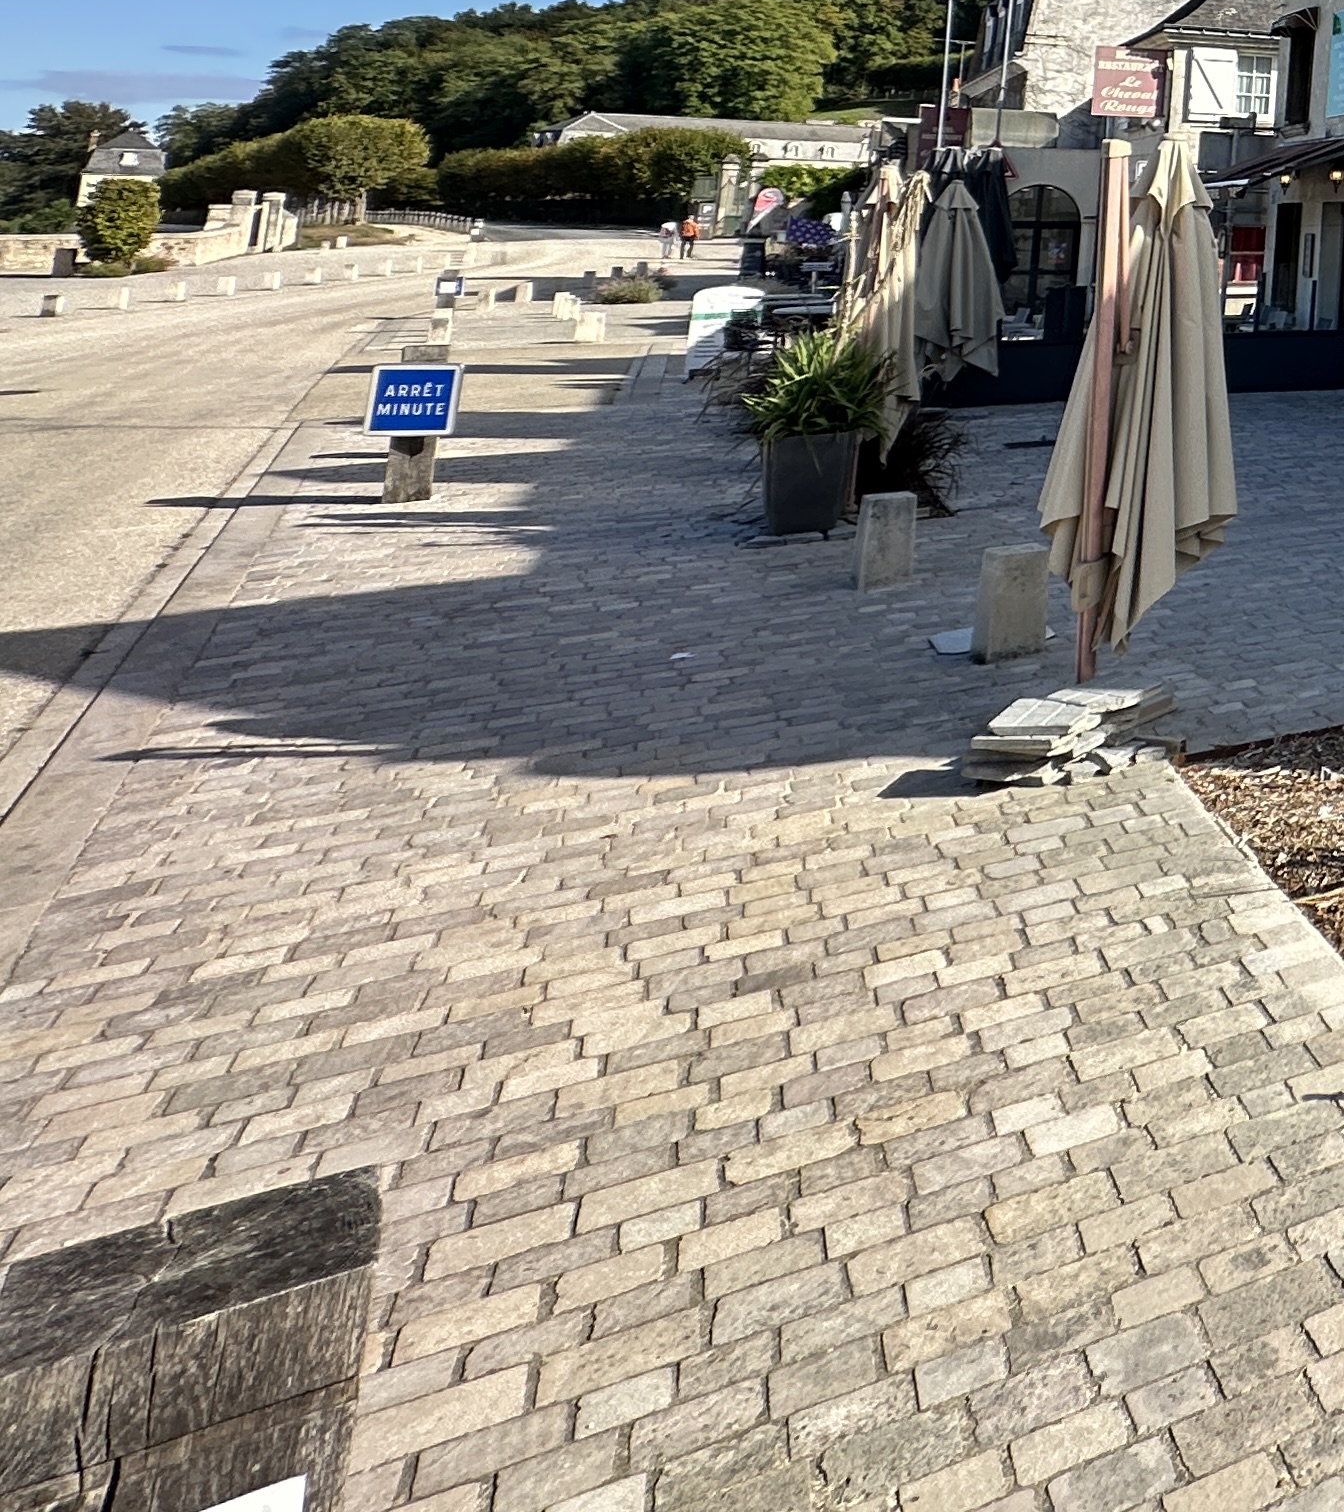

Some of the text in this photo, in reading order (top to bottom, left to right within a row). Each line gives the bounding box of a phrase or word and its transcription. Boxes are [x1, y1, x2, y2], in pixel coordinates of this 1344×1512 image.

[1100, 85, 1159, 100] Cheval
[1099, 99, 1157, 115] Rouge
[383, 382, 445, 398] ARRÊT
[376, 402, 447, 416] MINUTE
